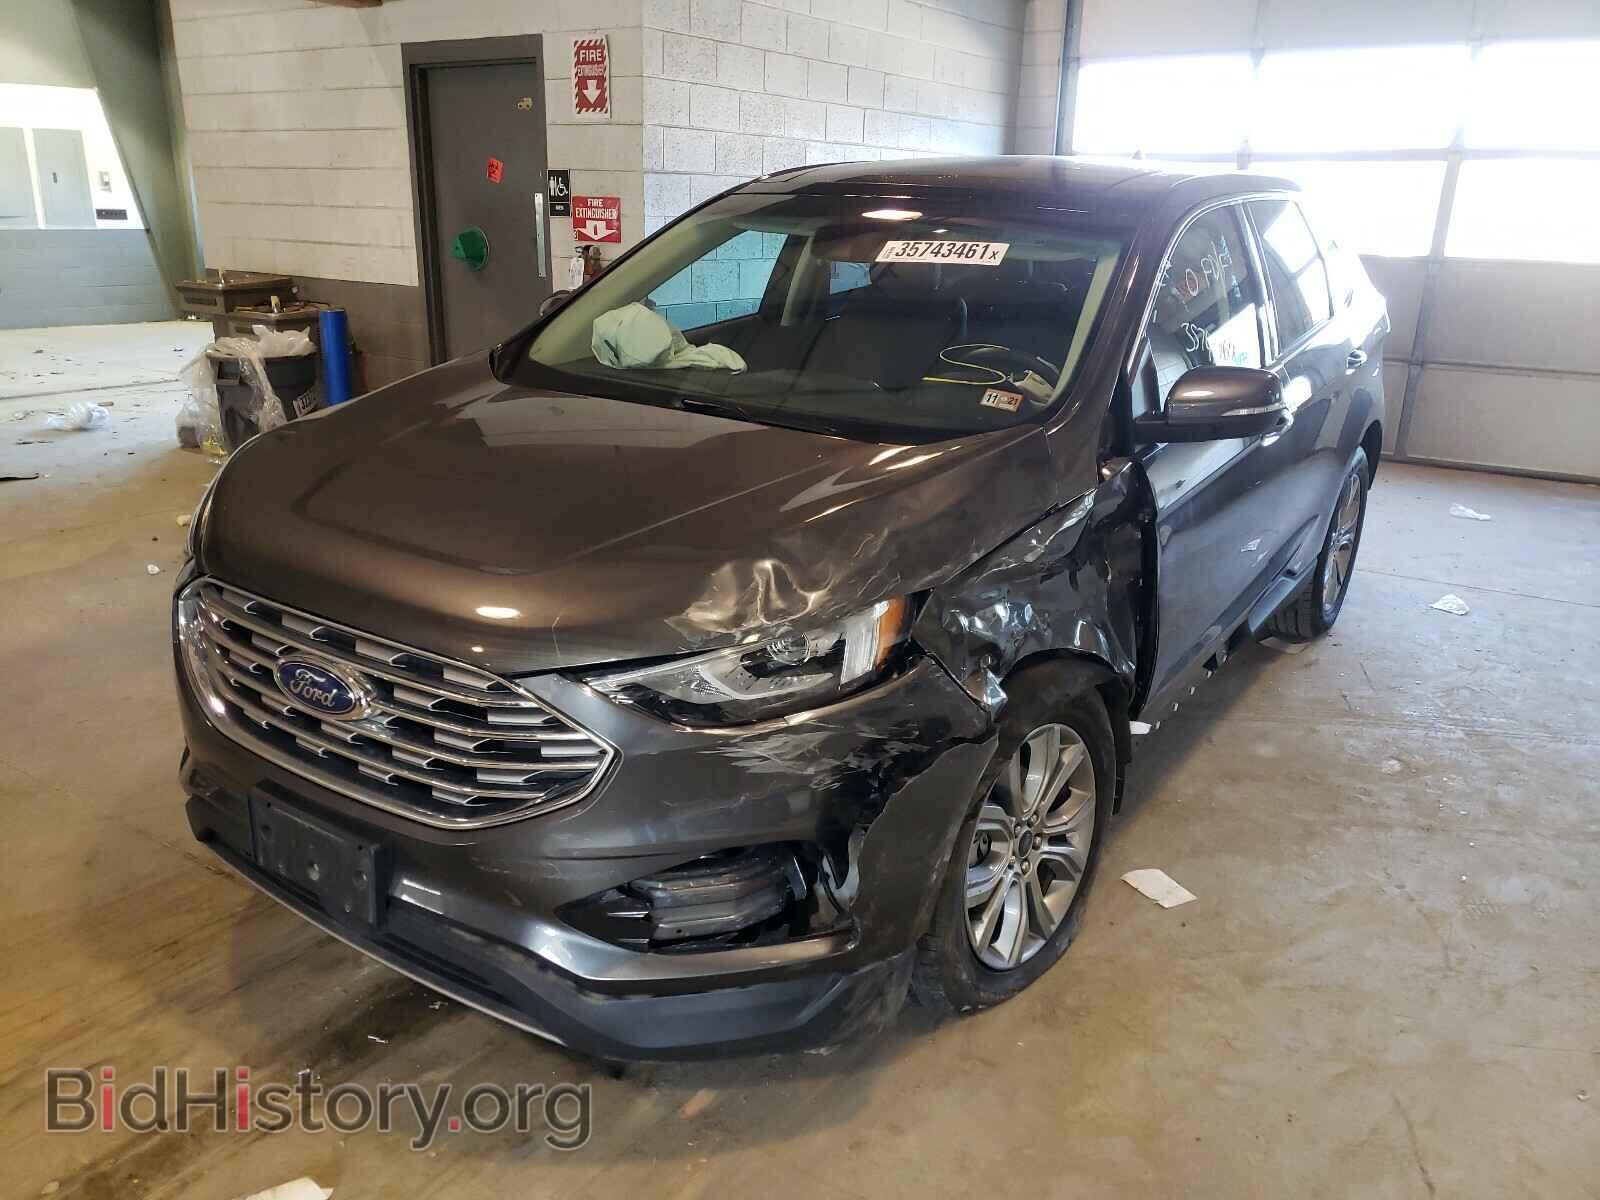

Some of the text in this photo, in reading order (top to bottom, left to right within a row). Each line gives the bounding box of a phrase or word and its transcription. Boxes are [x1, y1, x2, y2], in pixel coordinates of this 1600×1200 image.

[579, 49, 602, 62] FIRE
[587, 198, 604, 207] FIRE
[575, 208, 618, 220] EXTINGUISHER
[290, 668, 338, 707] Ford
